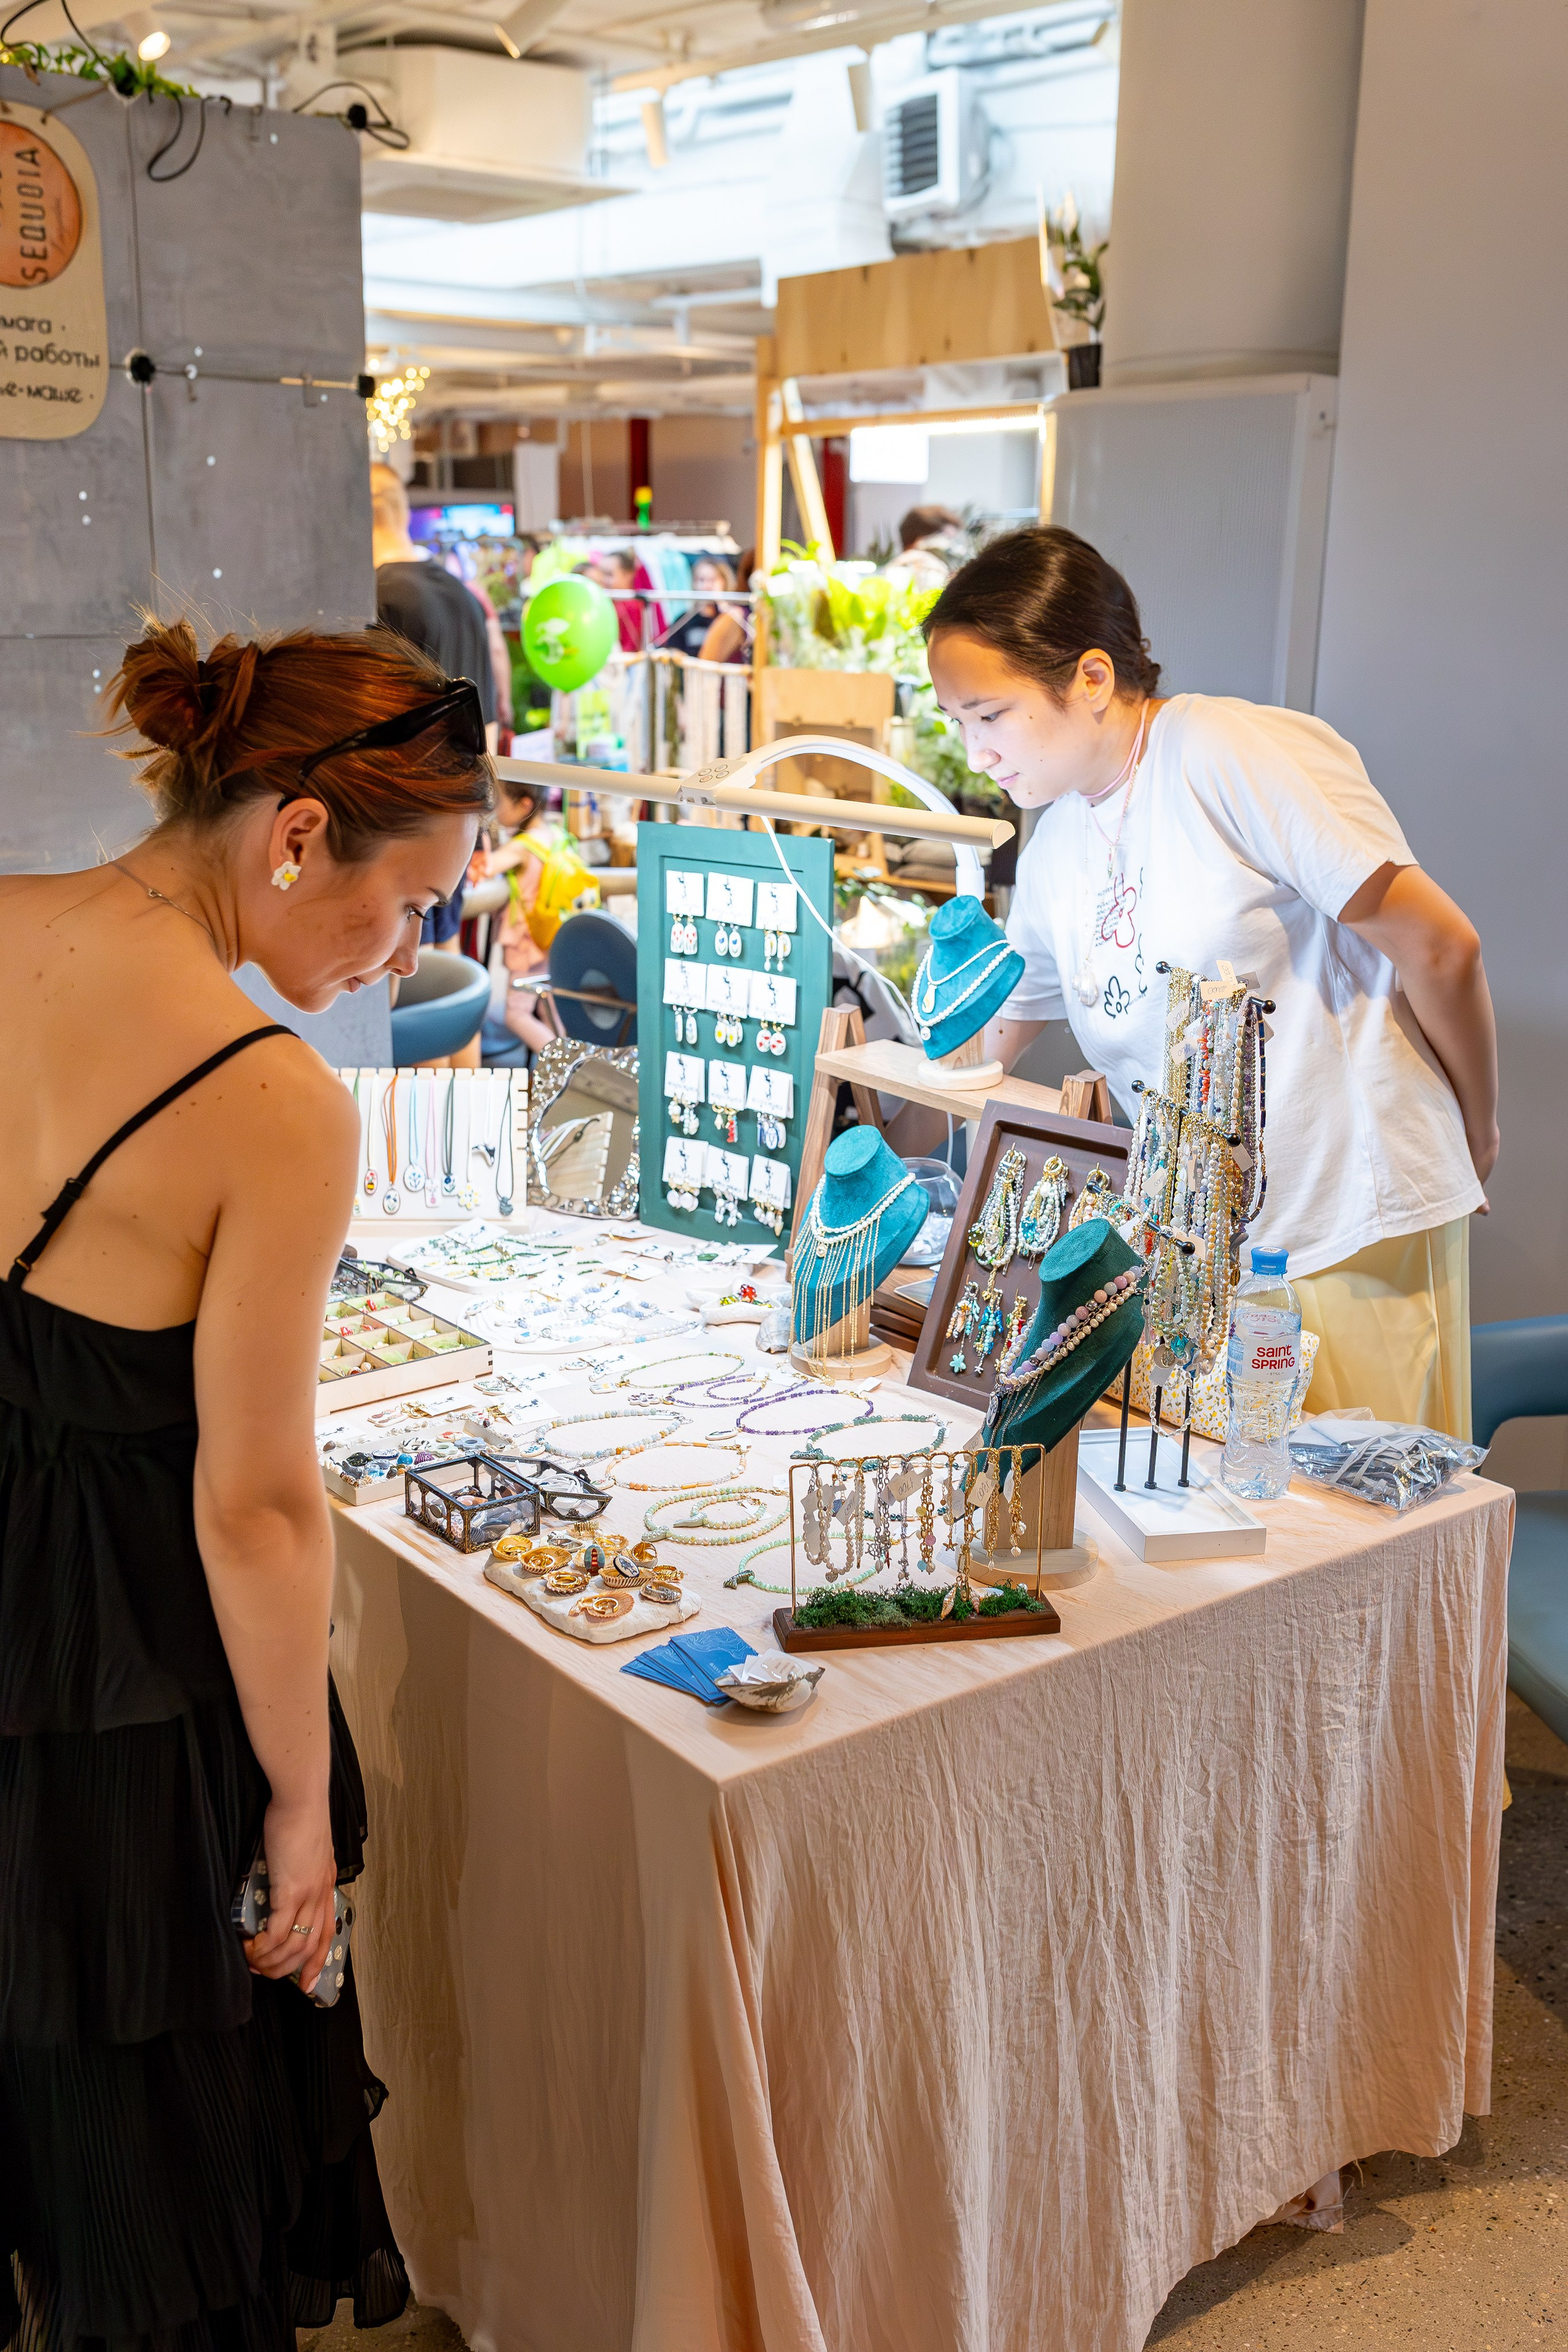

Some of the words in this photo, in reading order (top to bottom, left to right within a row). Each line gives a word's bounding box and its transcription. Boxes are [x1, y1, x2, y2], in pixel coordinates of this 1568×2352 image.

[15, 146, 48, 282] SEQUOIA
[15, 342, 100, 368] работы
[898, 1477, 914, 1496] 1700
